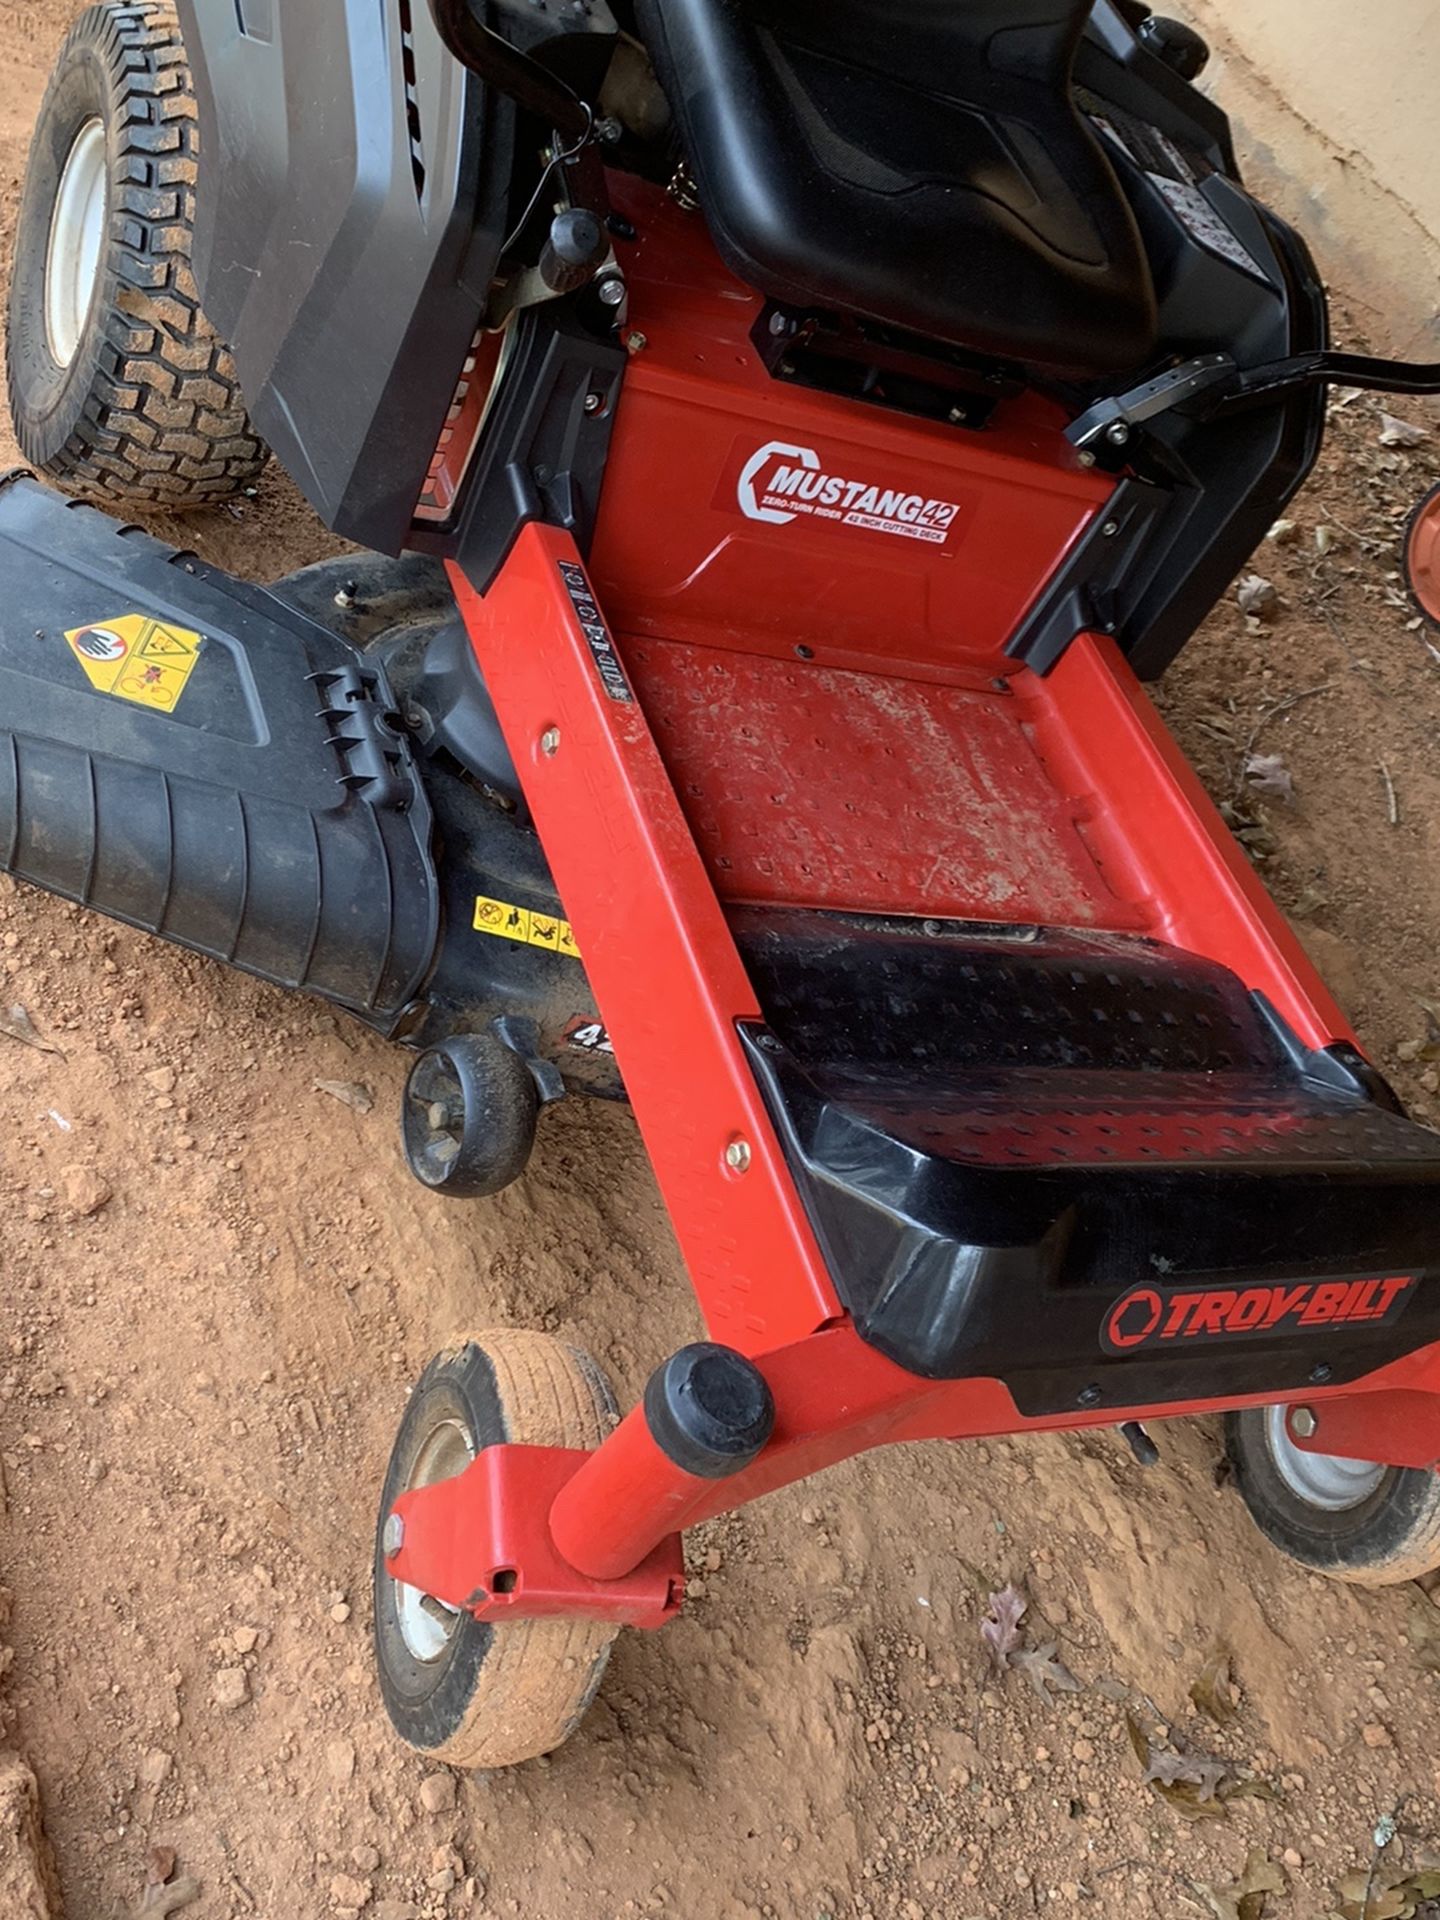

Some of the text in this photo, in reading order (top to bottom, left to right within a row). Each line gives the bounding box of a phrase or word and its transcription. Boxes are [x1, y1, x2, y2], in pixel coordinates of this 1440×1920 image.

[761, 495, 842, 520] ZERO-TURN RIDER
[860, 517, 882, 527] INCH
[882, 521, 919, 536] CUTTING
[918, 529, 944, 541] DECK
[1160, 1276, 1411, 1338] TROY-BILT
